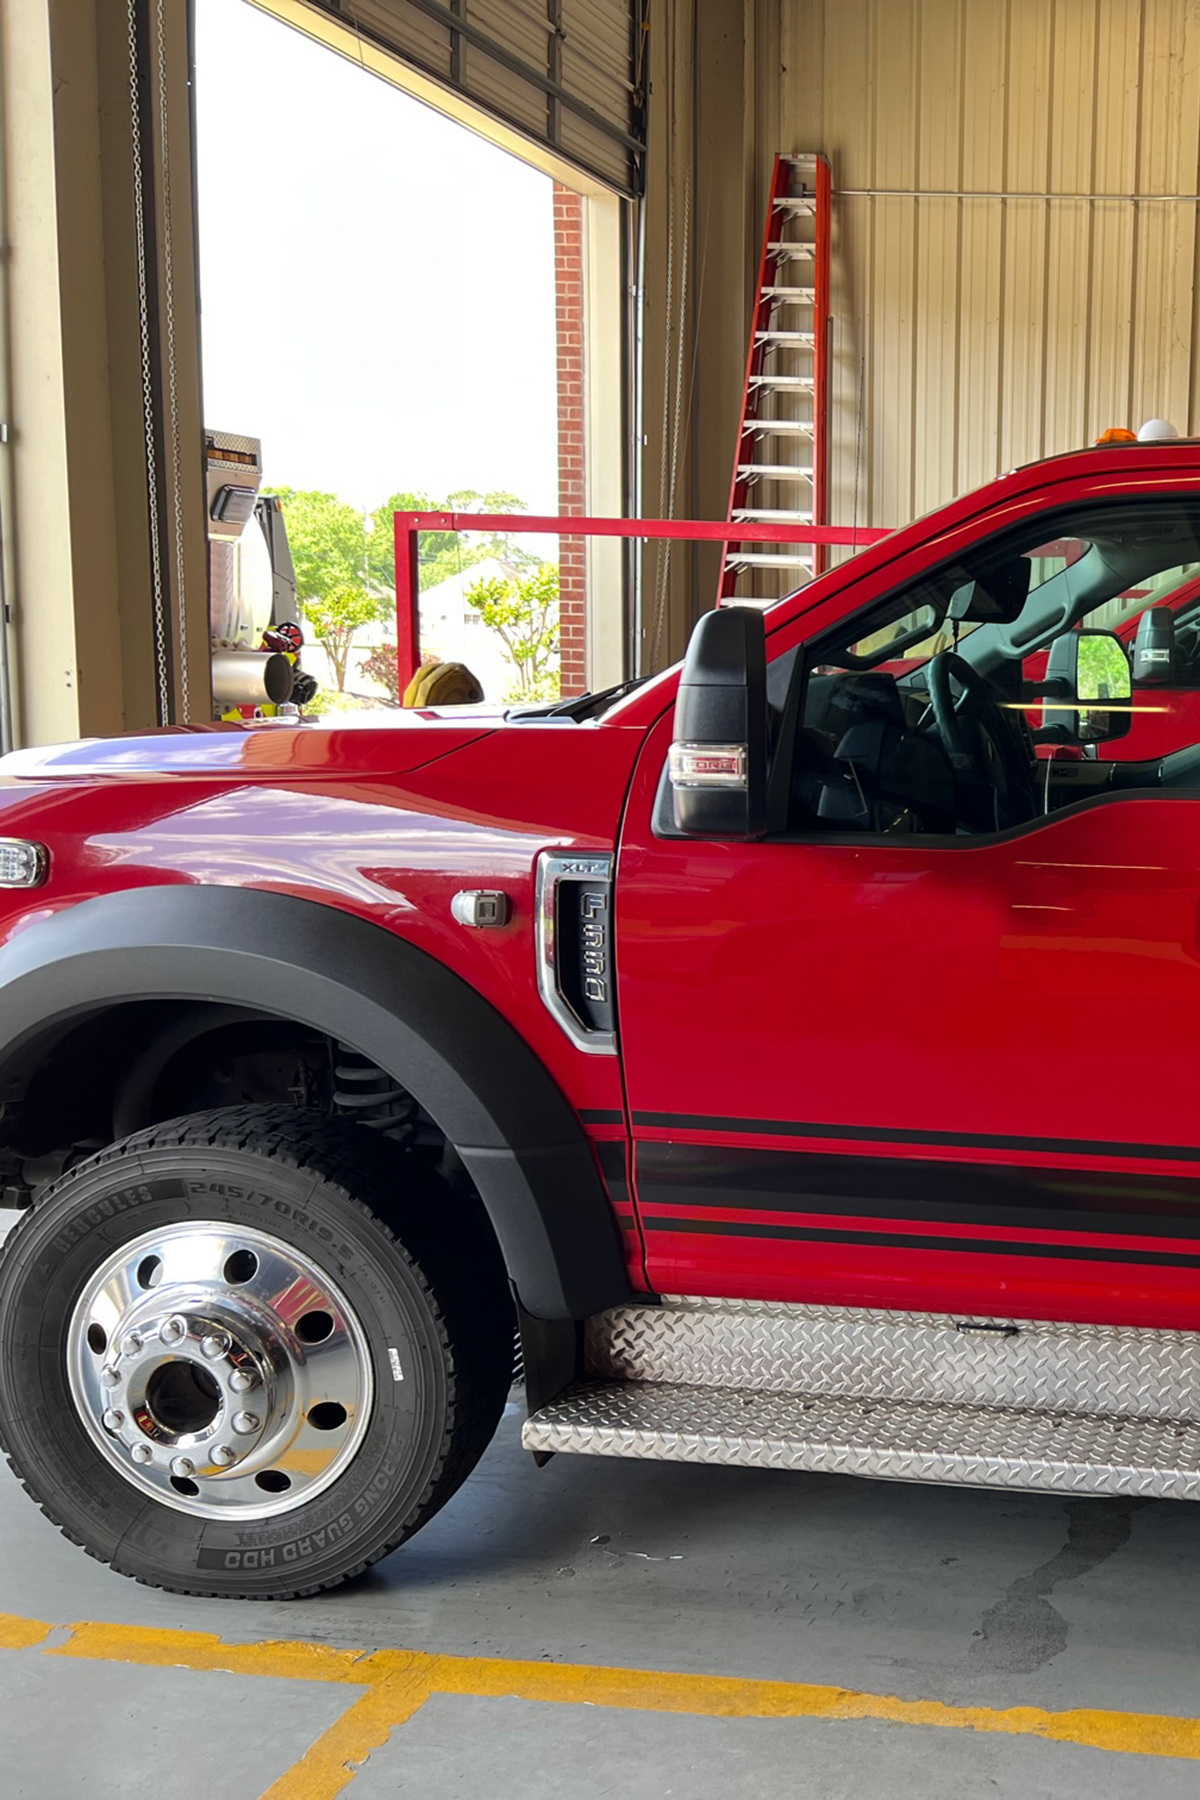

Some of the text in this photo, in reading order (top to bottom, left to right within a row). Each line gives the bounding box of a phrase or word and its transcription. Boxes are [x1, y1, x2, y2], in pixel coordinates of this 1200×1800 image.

[562, 863, 596, 874] XLT
[52, 1186, 153, 1252] HERCULES
[189, 1181, 355, 1262] 245/70R19.5
[354, 1431, 407, 1517] STRONG
[283, 1513, 354, 1561] GUARD
